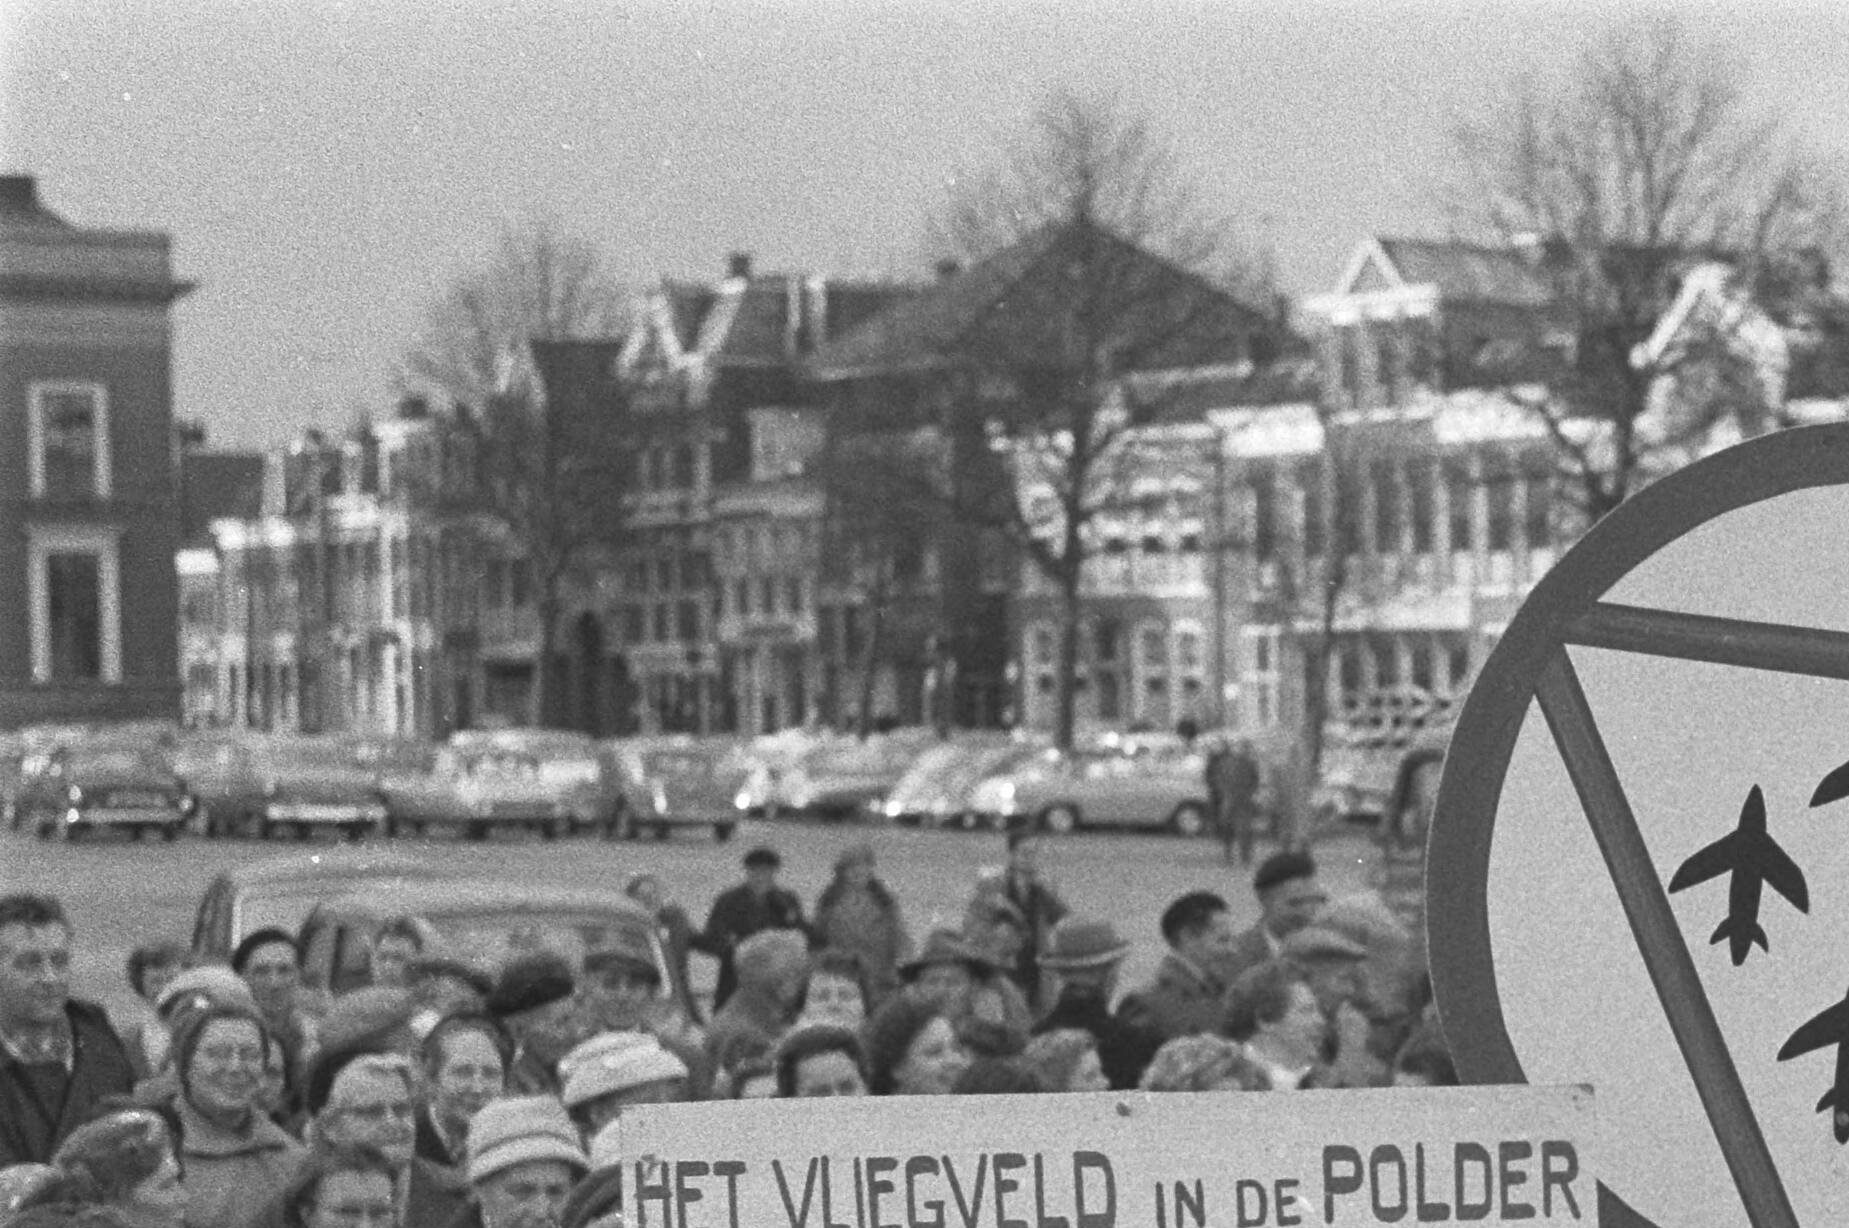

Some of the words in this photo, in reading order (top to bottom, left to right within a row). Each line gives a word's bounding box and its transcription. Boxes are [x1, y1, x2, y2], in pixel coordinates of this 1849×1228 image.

[1155, 1180, 1207, 1228] IN
[1235, 1177, 1302, 1228] DE
[1322, 1140, 1581, 1224] POLDER
